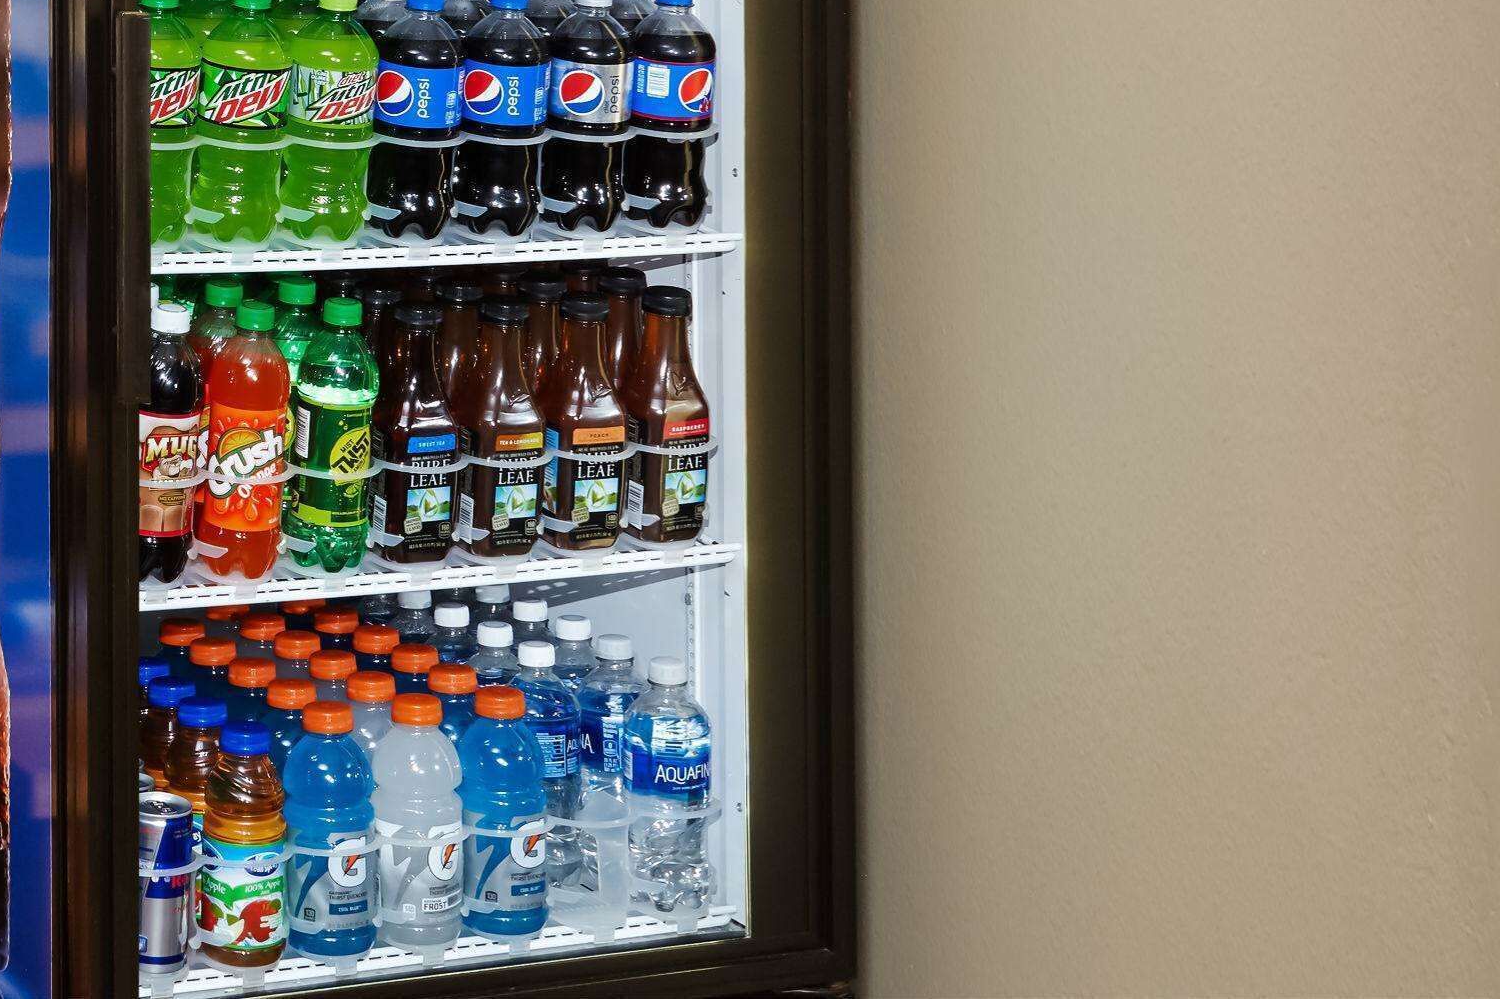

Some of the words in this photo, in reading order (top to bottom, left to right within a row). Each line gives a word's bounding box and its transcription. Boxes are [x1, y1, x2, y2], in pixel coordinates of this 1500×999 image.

[417, 78, 430, 118] pepsi
[507, 76, 519, 116] pepsi
[609, 74, 620, 113] pepsi
[146, 436, 198, 463] MUG
[208, 429, 283, 496] Crush
[577, 465, 615, 479] LEAF
[668, 456, 703, 471] LEAF
[410, 474, 447, 488] LEAF
[498, 471, 534, 485] LEAF
[654, 763, 710, 785] AQUAFIN
[424, 901, 448, 911] FROST
